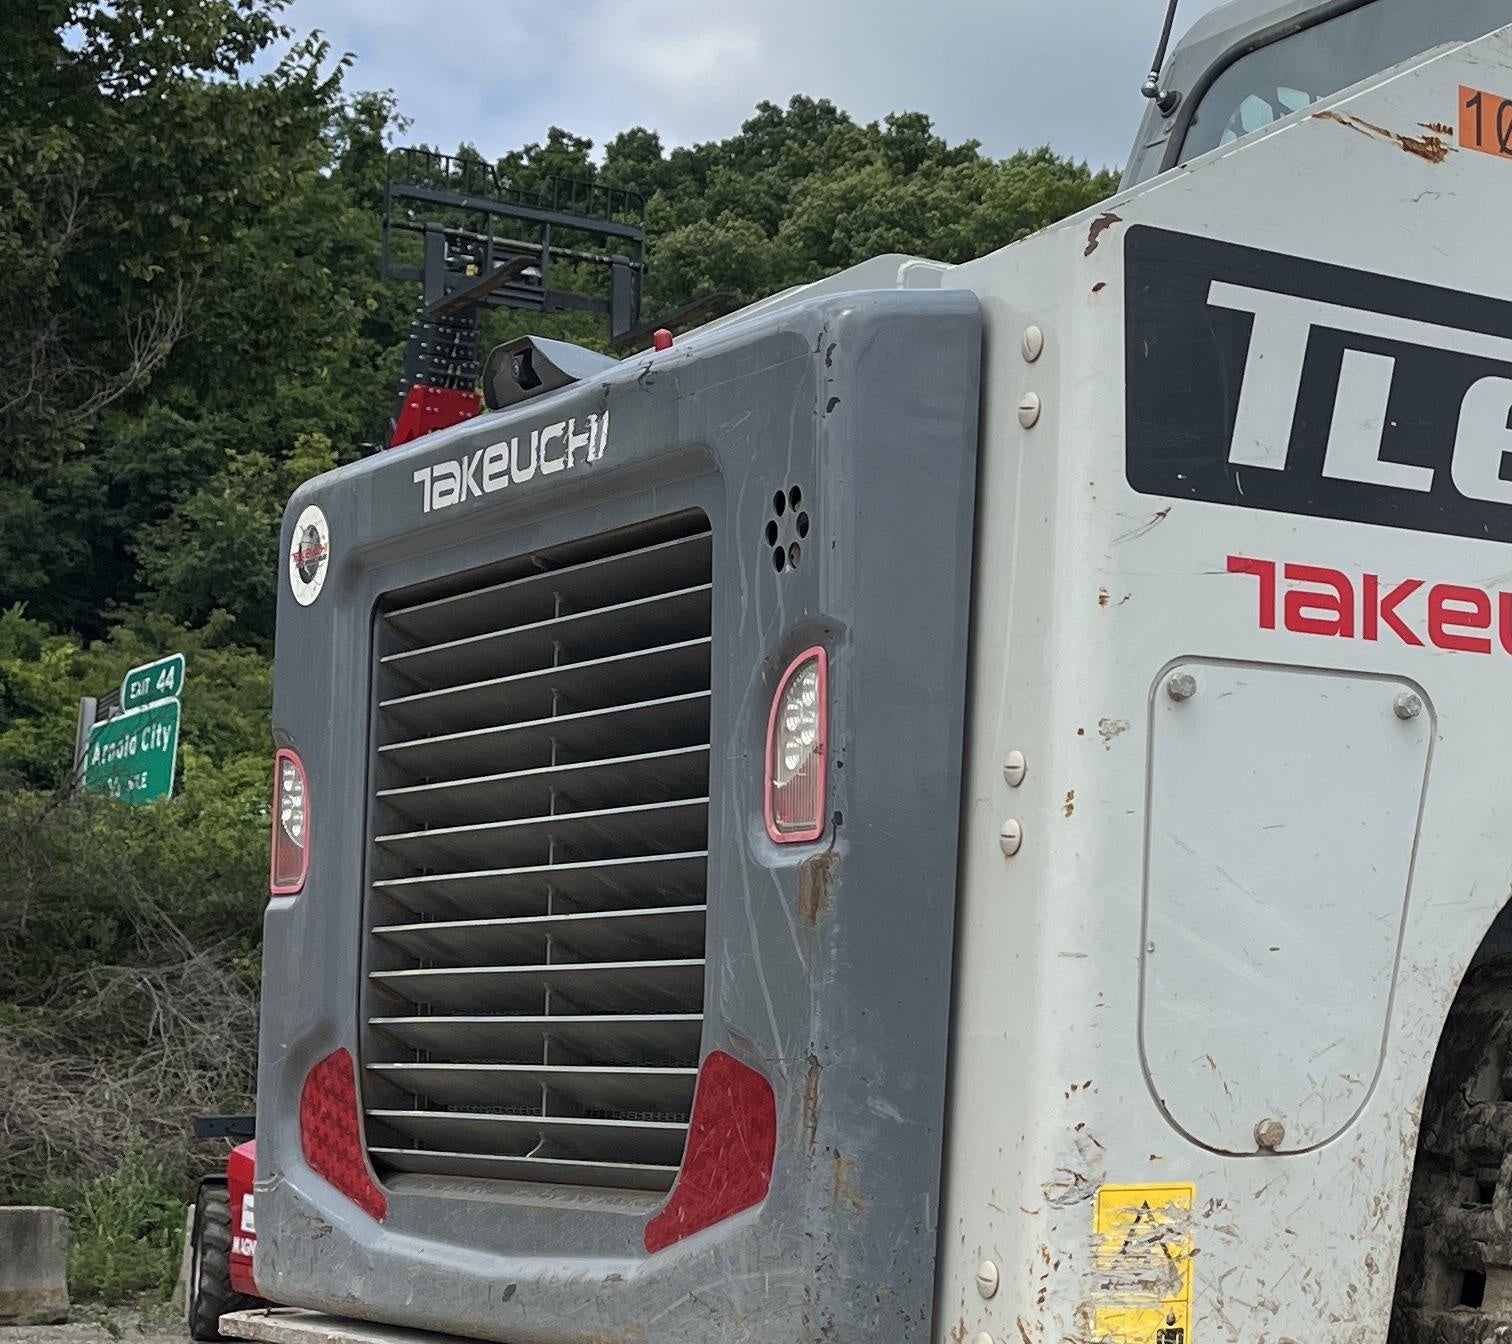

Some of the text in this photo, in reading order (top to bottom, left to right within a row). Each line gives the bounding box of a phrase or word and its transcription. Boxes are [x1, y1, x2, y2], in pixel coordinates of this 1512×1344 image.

[130, 665, 175, 699] EXIT 44
[141, 723, 172, 752] City
